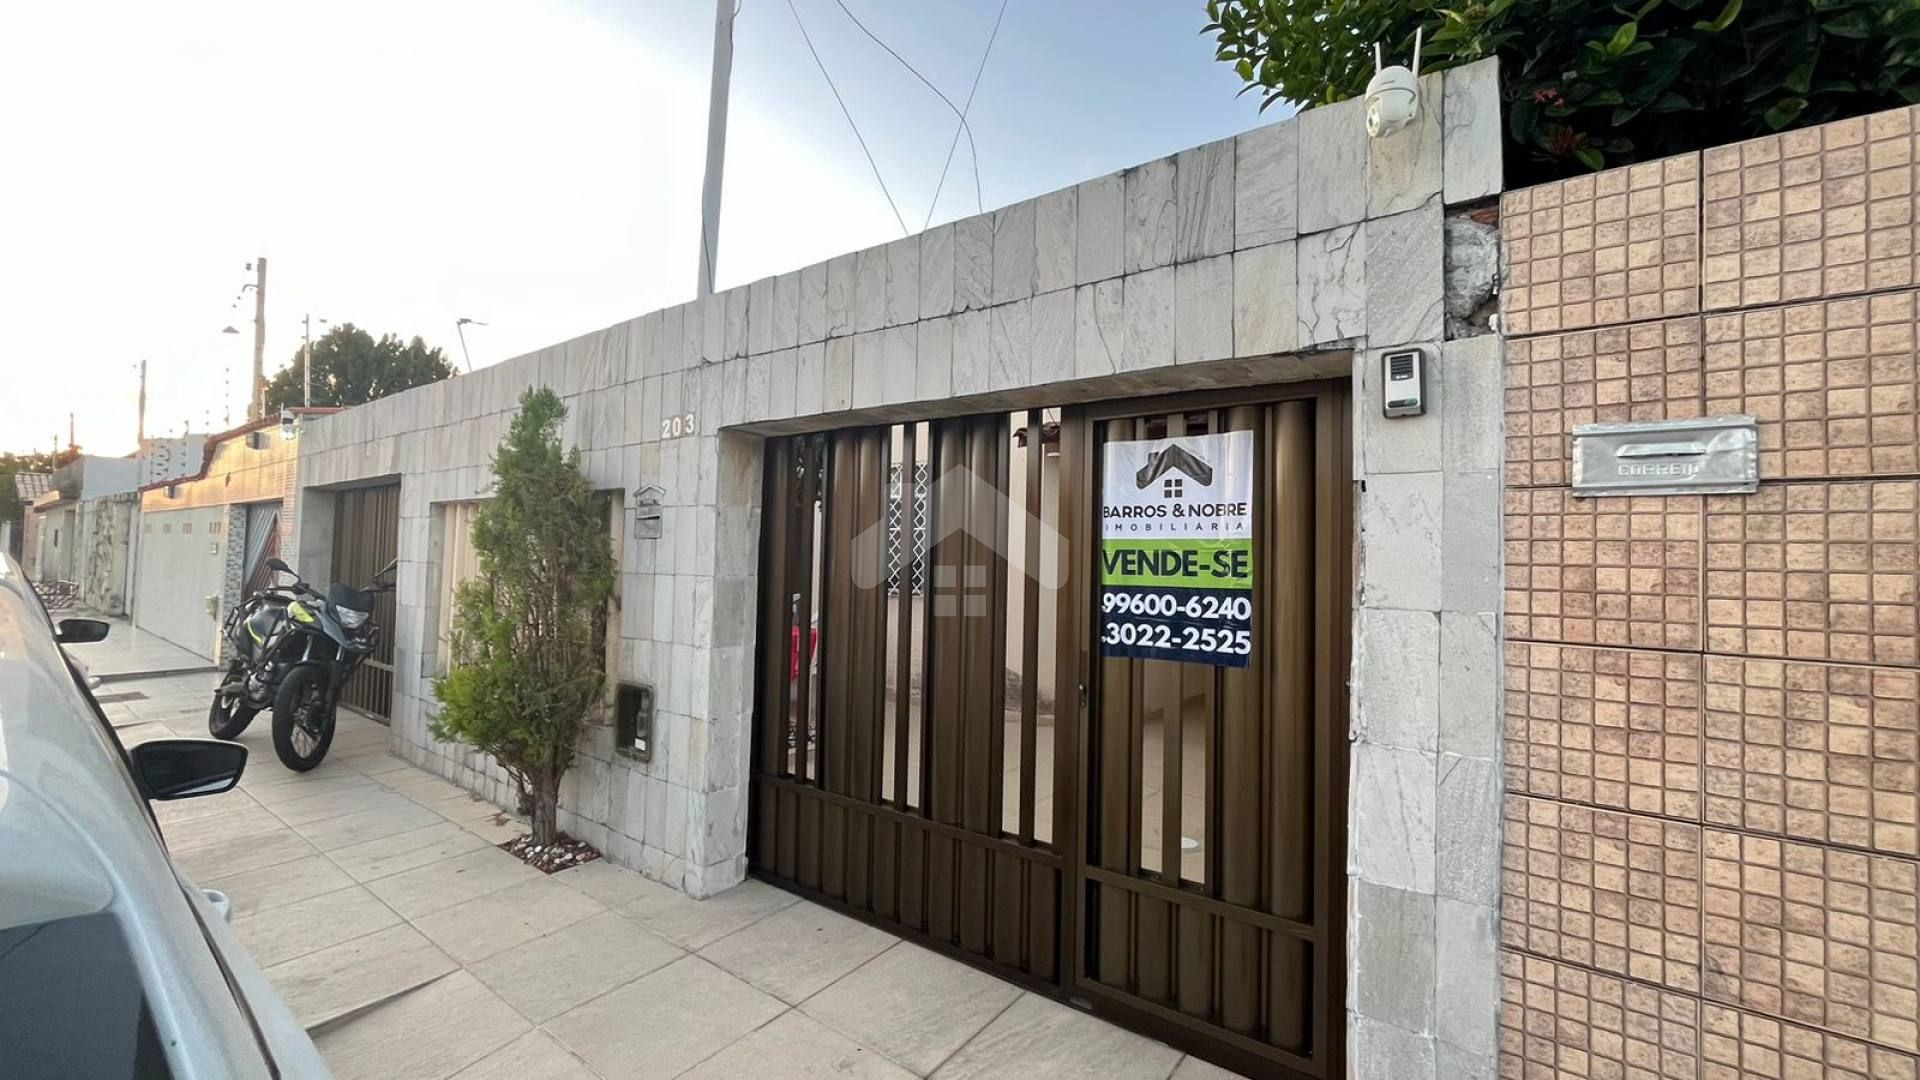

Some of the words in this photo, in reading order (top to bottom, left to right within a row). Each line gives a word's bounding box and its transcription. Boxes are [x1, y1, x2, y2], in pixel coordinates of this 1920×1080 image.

[662, 414, 695, 438] 203
[1104, 504, 1167, 518] BARROS
[1173, 503, 1185, 516] &
[1188, 502, 1247, 516] NOBRE
[1103, 549, 1248, 578] VENDE-SE
[1102, 592, 1251, 620] 99600-6240
